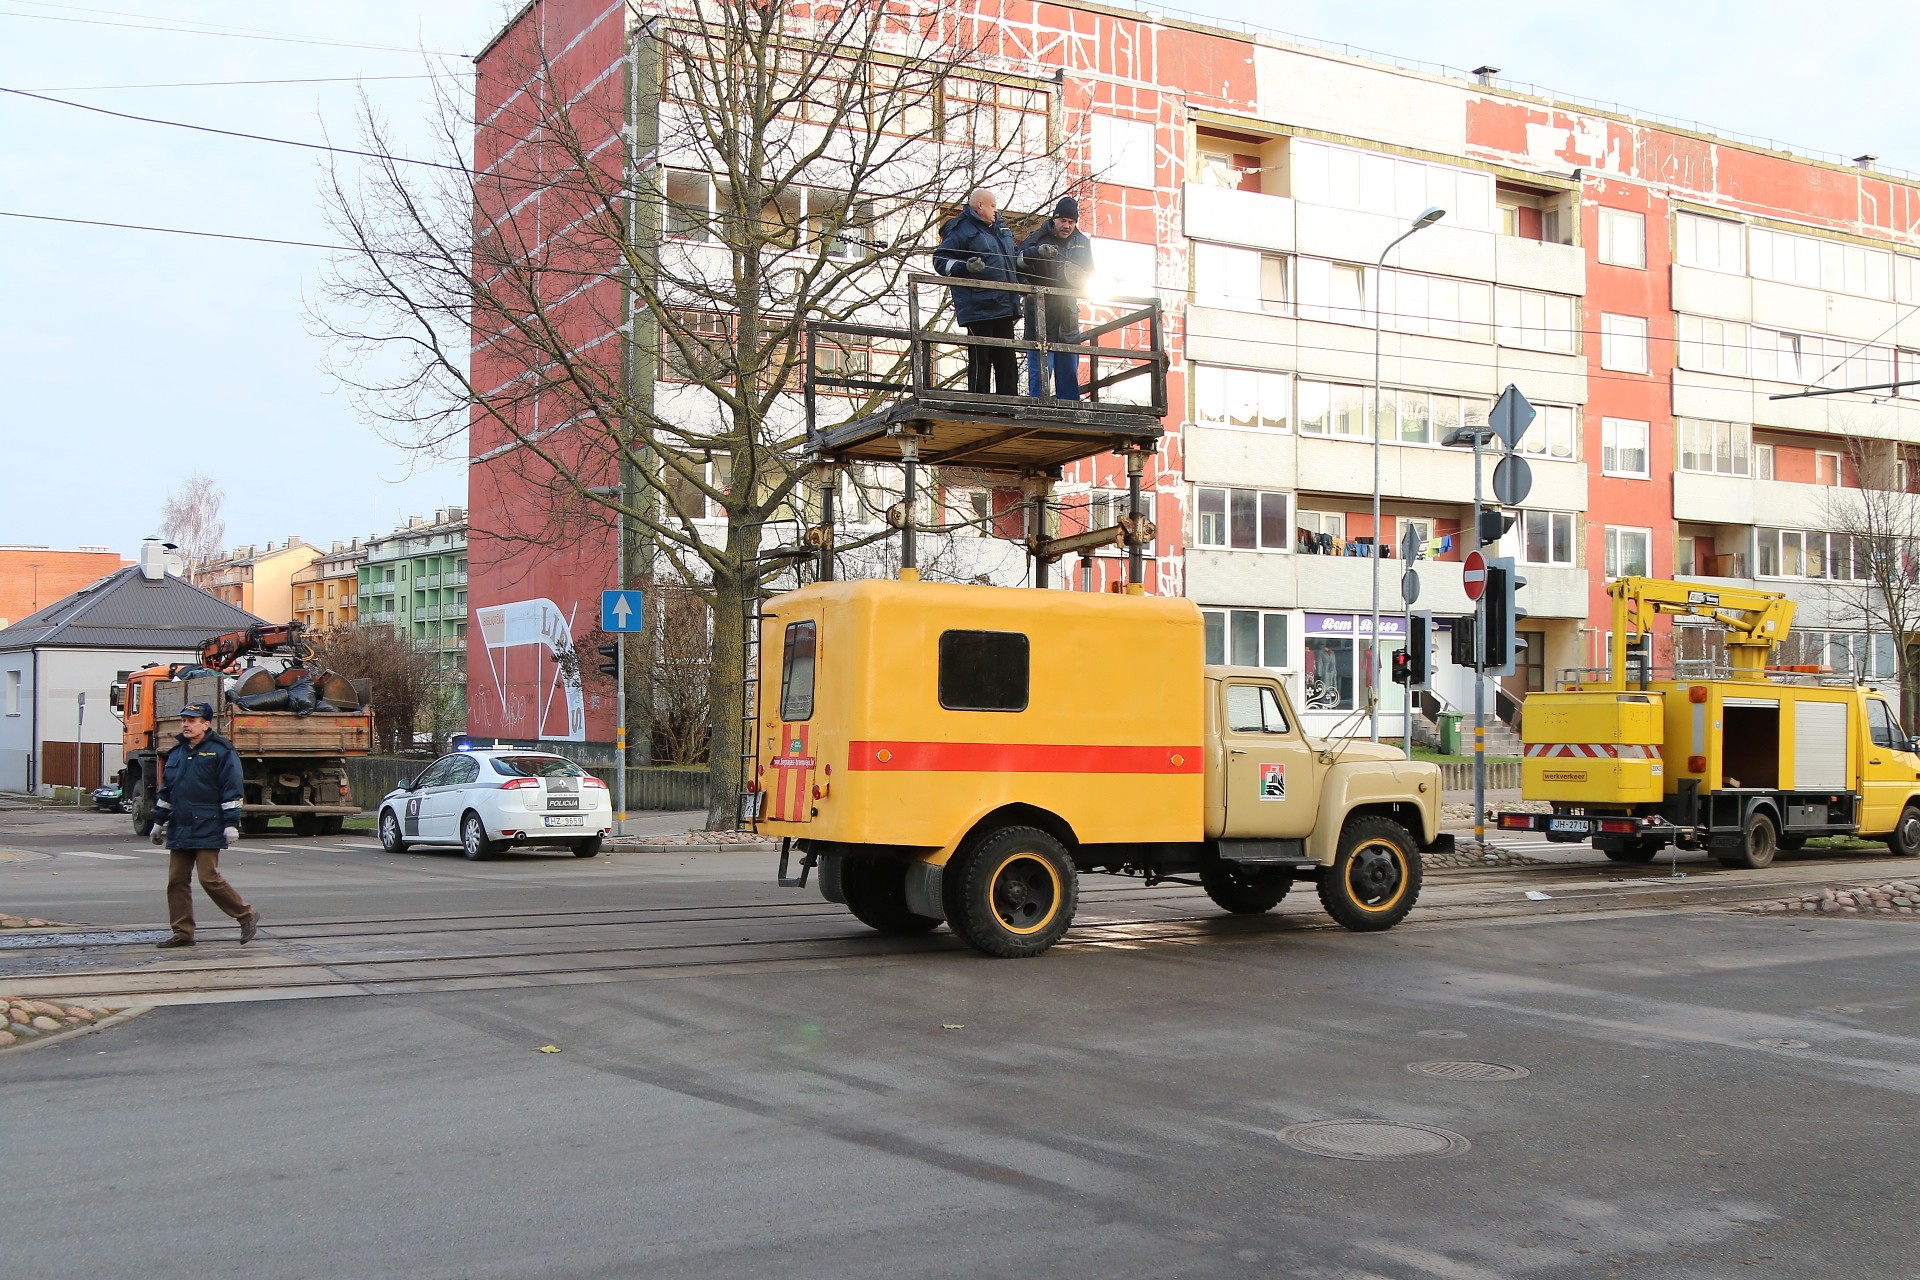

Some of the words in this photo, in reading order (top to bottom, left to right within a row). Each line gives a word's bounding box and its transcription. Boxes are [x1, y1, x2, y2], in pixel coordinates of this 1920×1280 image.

[1360, 619, 1399, 632] Rsso
[1544, 772, 1585, 780] werkverkeer
[1554, 819, 1588, 830] JH-2714
